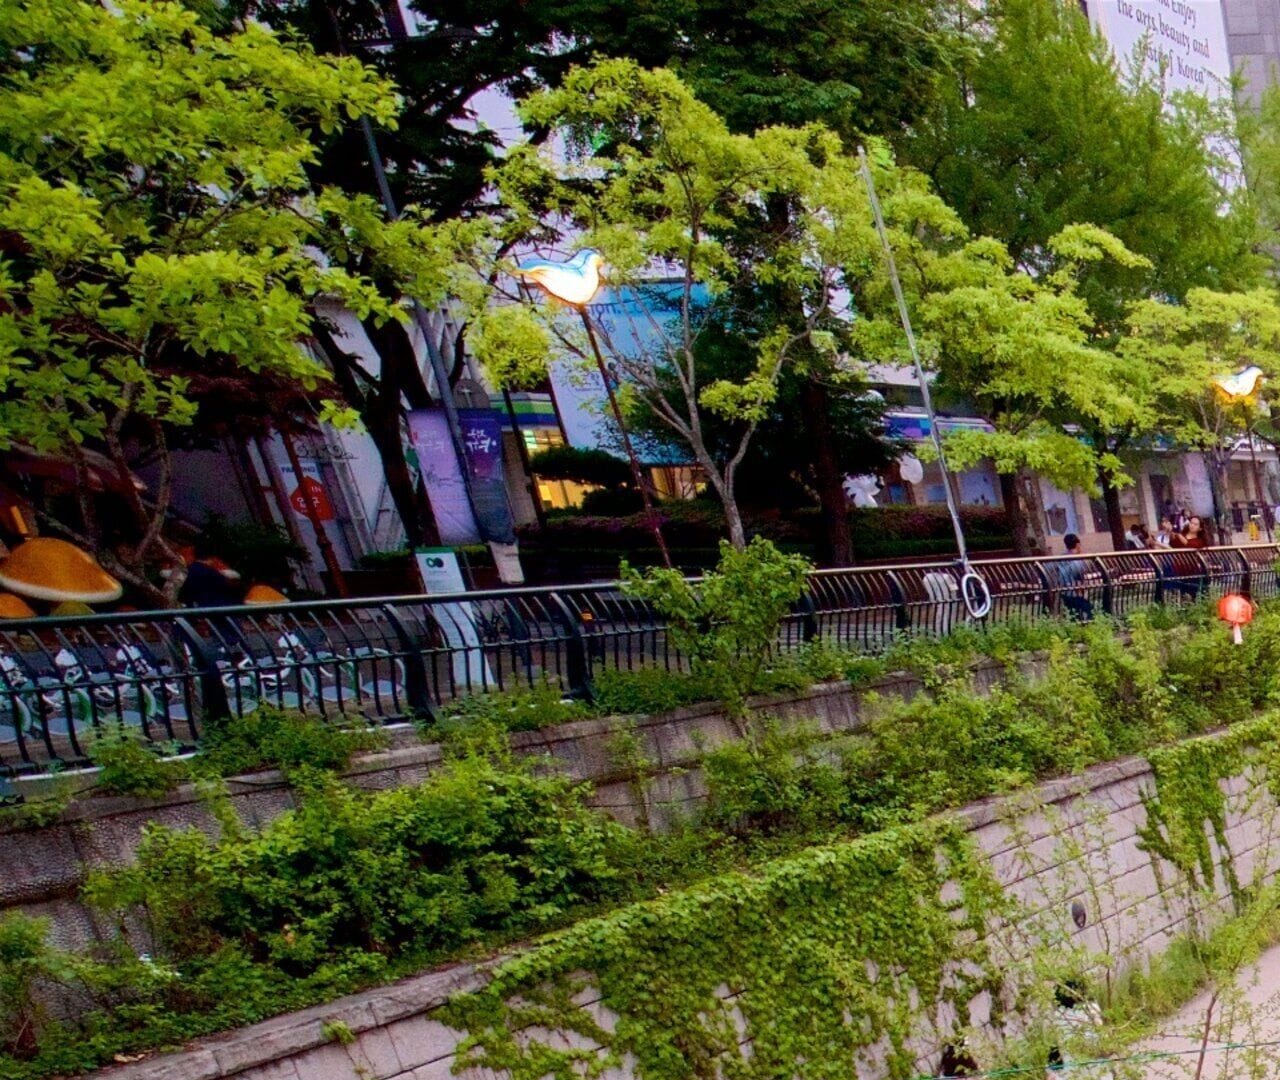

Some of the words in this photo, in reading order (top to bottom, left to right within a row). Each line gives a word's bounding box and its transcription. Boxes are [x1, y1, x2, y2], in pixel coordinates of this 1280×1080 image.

[1117, 0, 1133, 19] the
[1159, 12, 1190, 55] beauty
[1193, 37, 1210, 59] and
[1177, 55, 1205, 85] Korea
